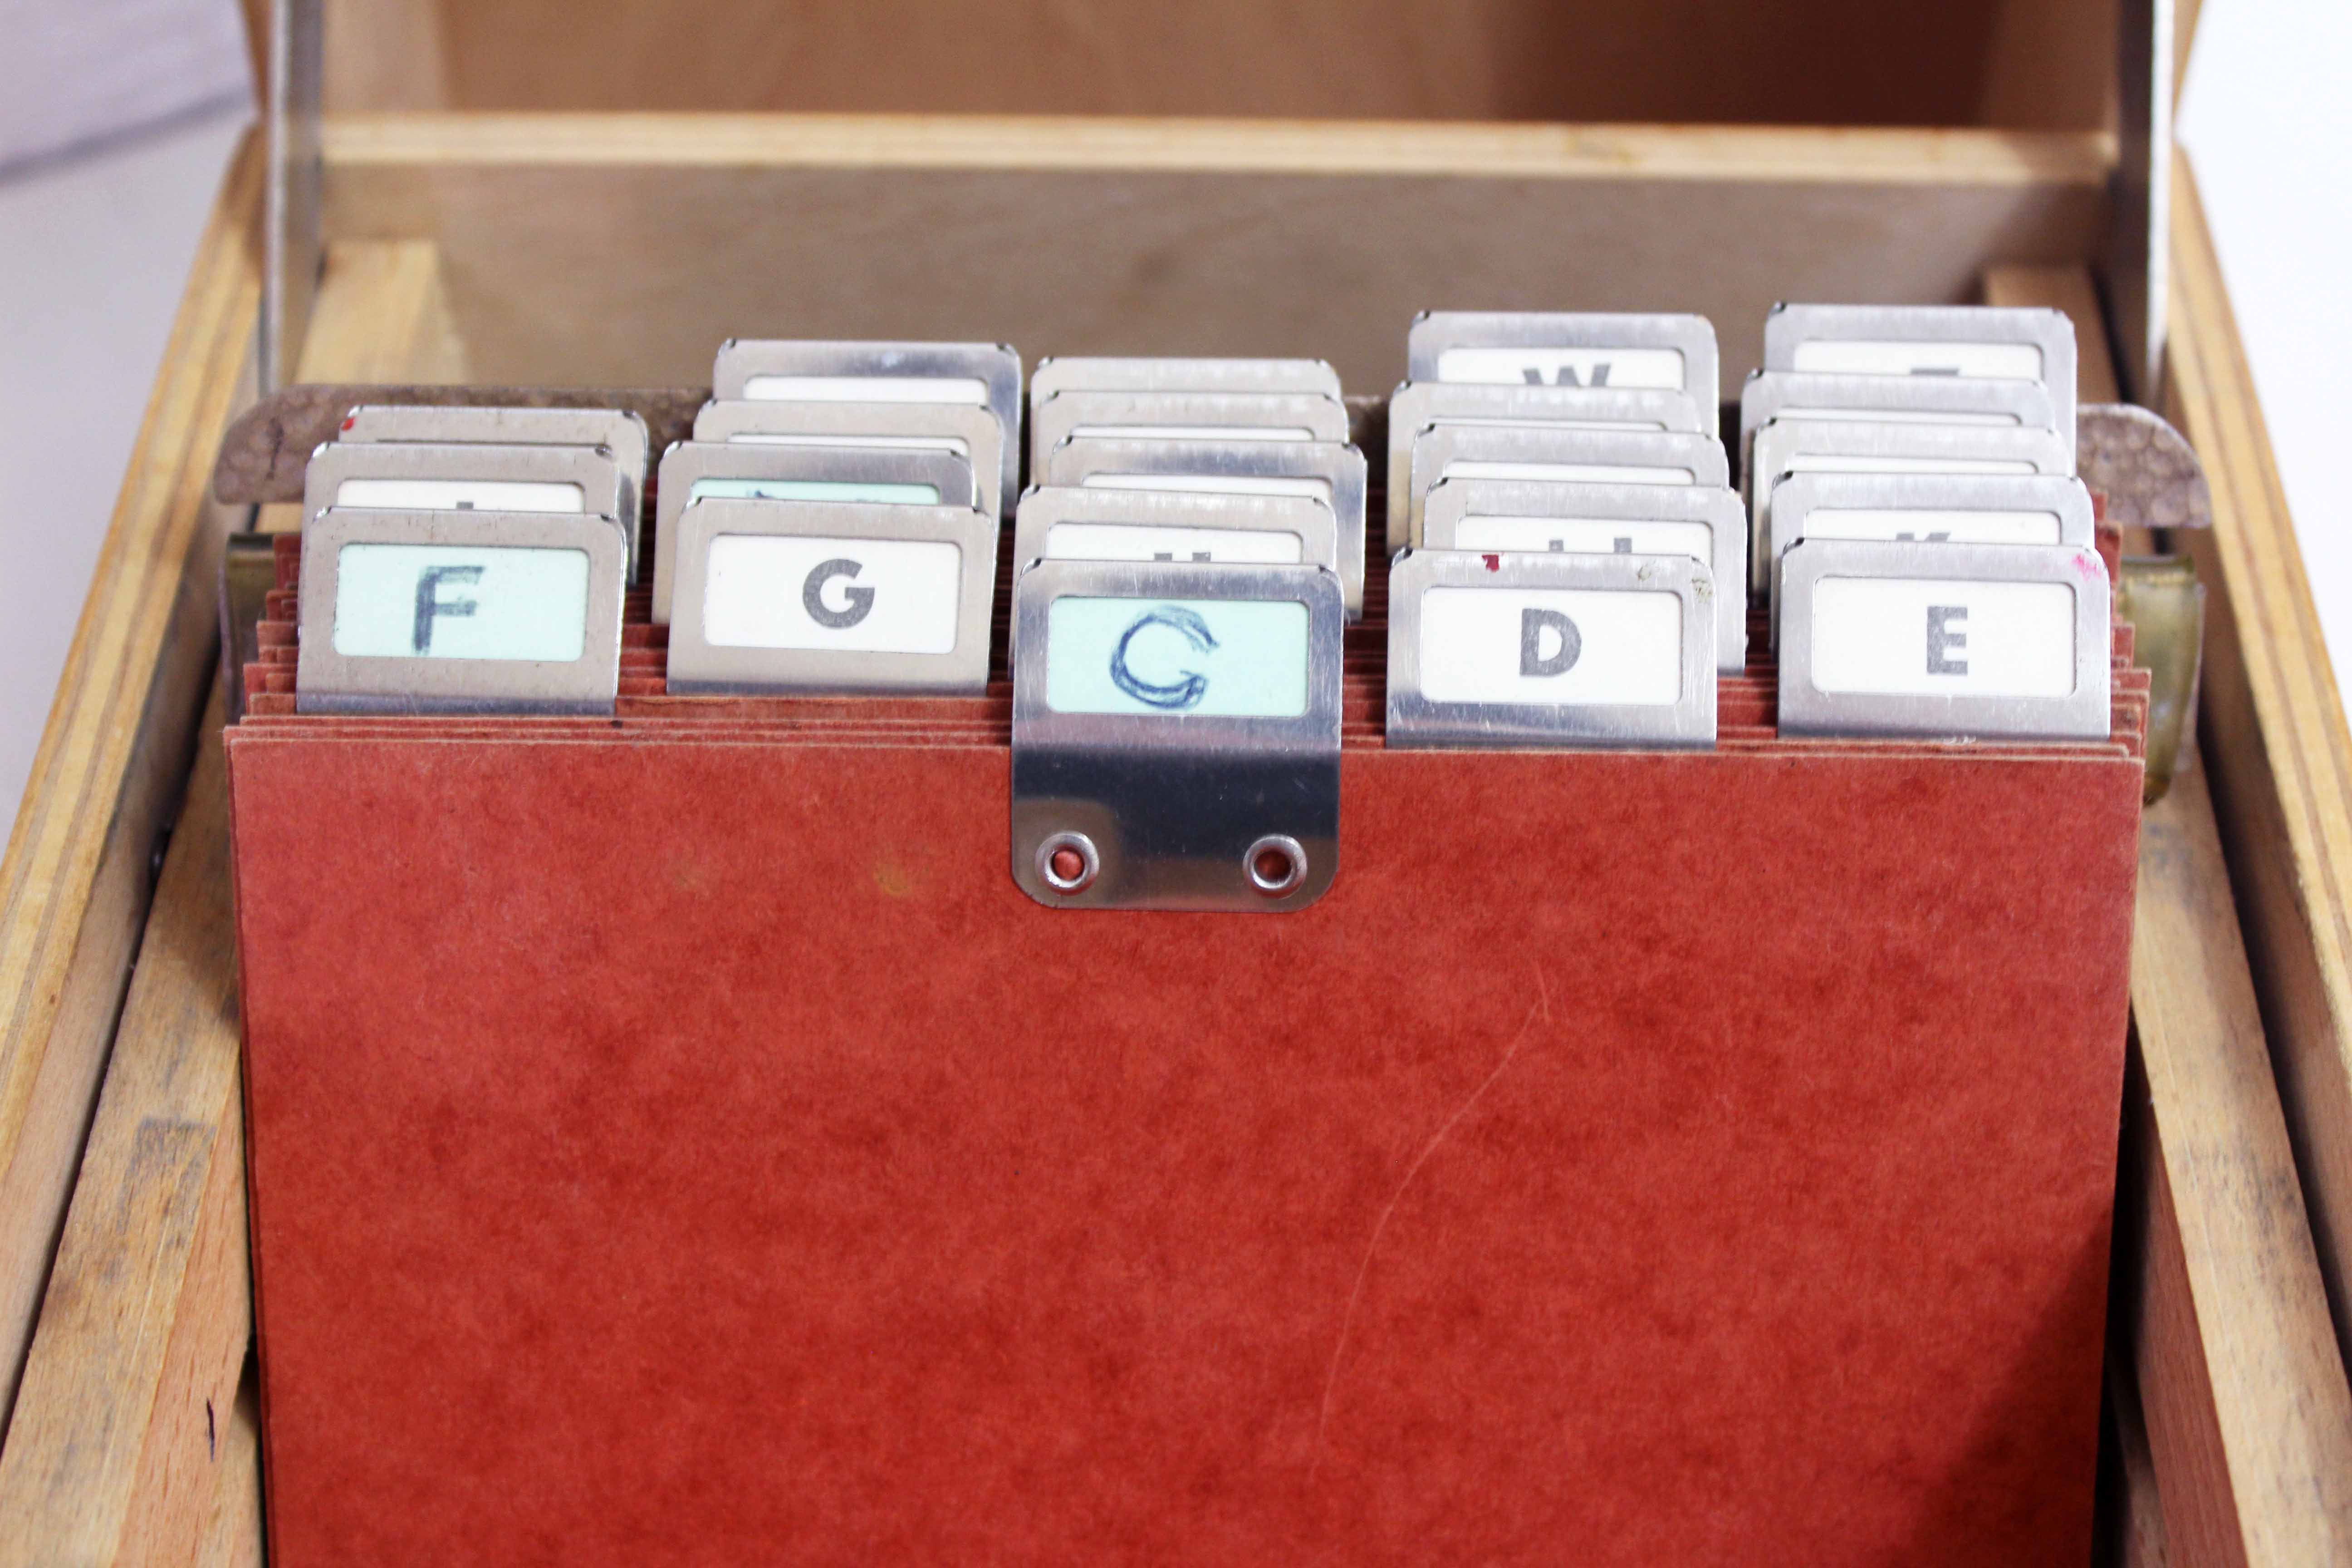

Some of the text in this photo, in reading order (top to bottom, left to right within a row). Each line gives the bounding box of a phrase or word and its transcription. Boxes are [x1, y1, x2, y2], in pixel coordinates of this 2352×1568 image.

[412, 565, 485, 653] F
[802, 559, 875, 629] G
[1519, 608, 1582, 677] D
[1926, 606, 1968, 675] E
